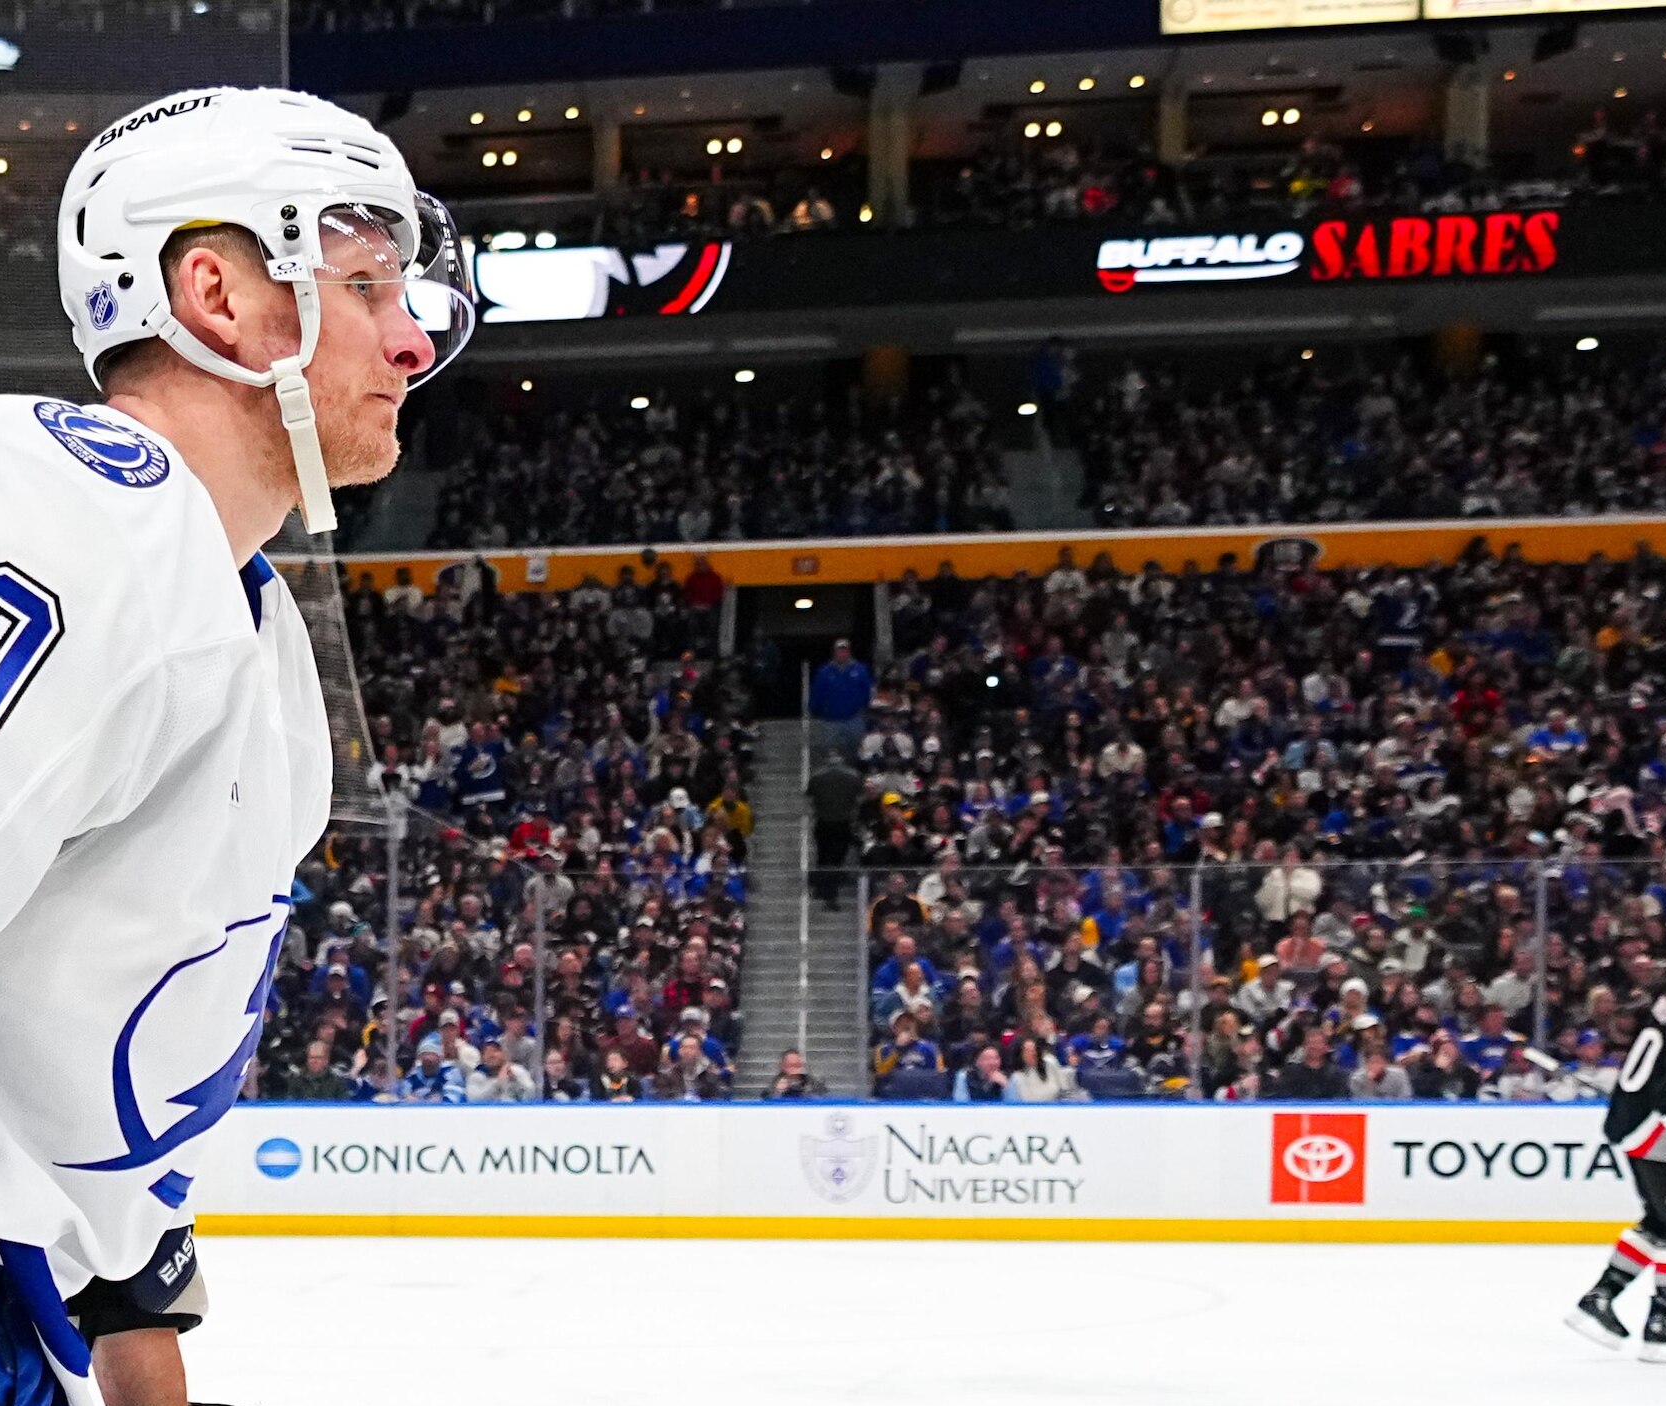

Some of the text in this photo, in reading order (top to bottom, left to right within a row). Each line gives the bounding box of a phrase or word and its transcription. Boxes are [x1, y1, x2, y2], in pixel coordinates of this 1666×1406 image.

[94, 94, 221, 152] BRANDT
[1096, 211, 1560, 281] BUFFALO SABRES
[312, 1144, 656, 1175] KONICA MINOLTA
[884, 1124, 1082, 1166] NIAGARA
[1392, 1141, 1624, 1180] TOYOTA
[884, 1169, 1085, 1204] UNIVERSITY
